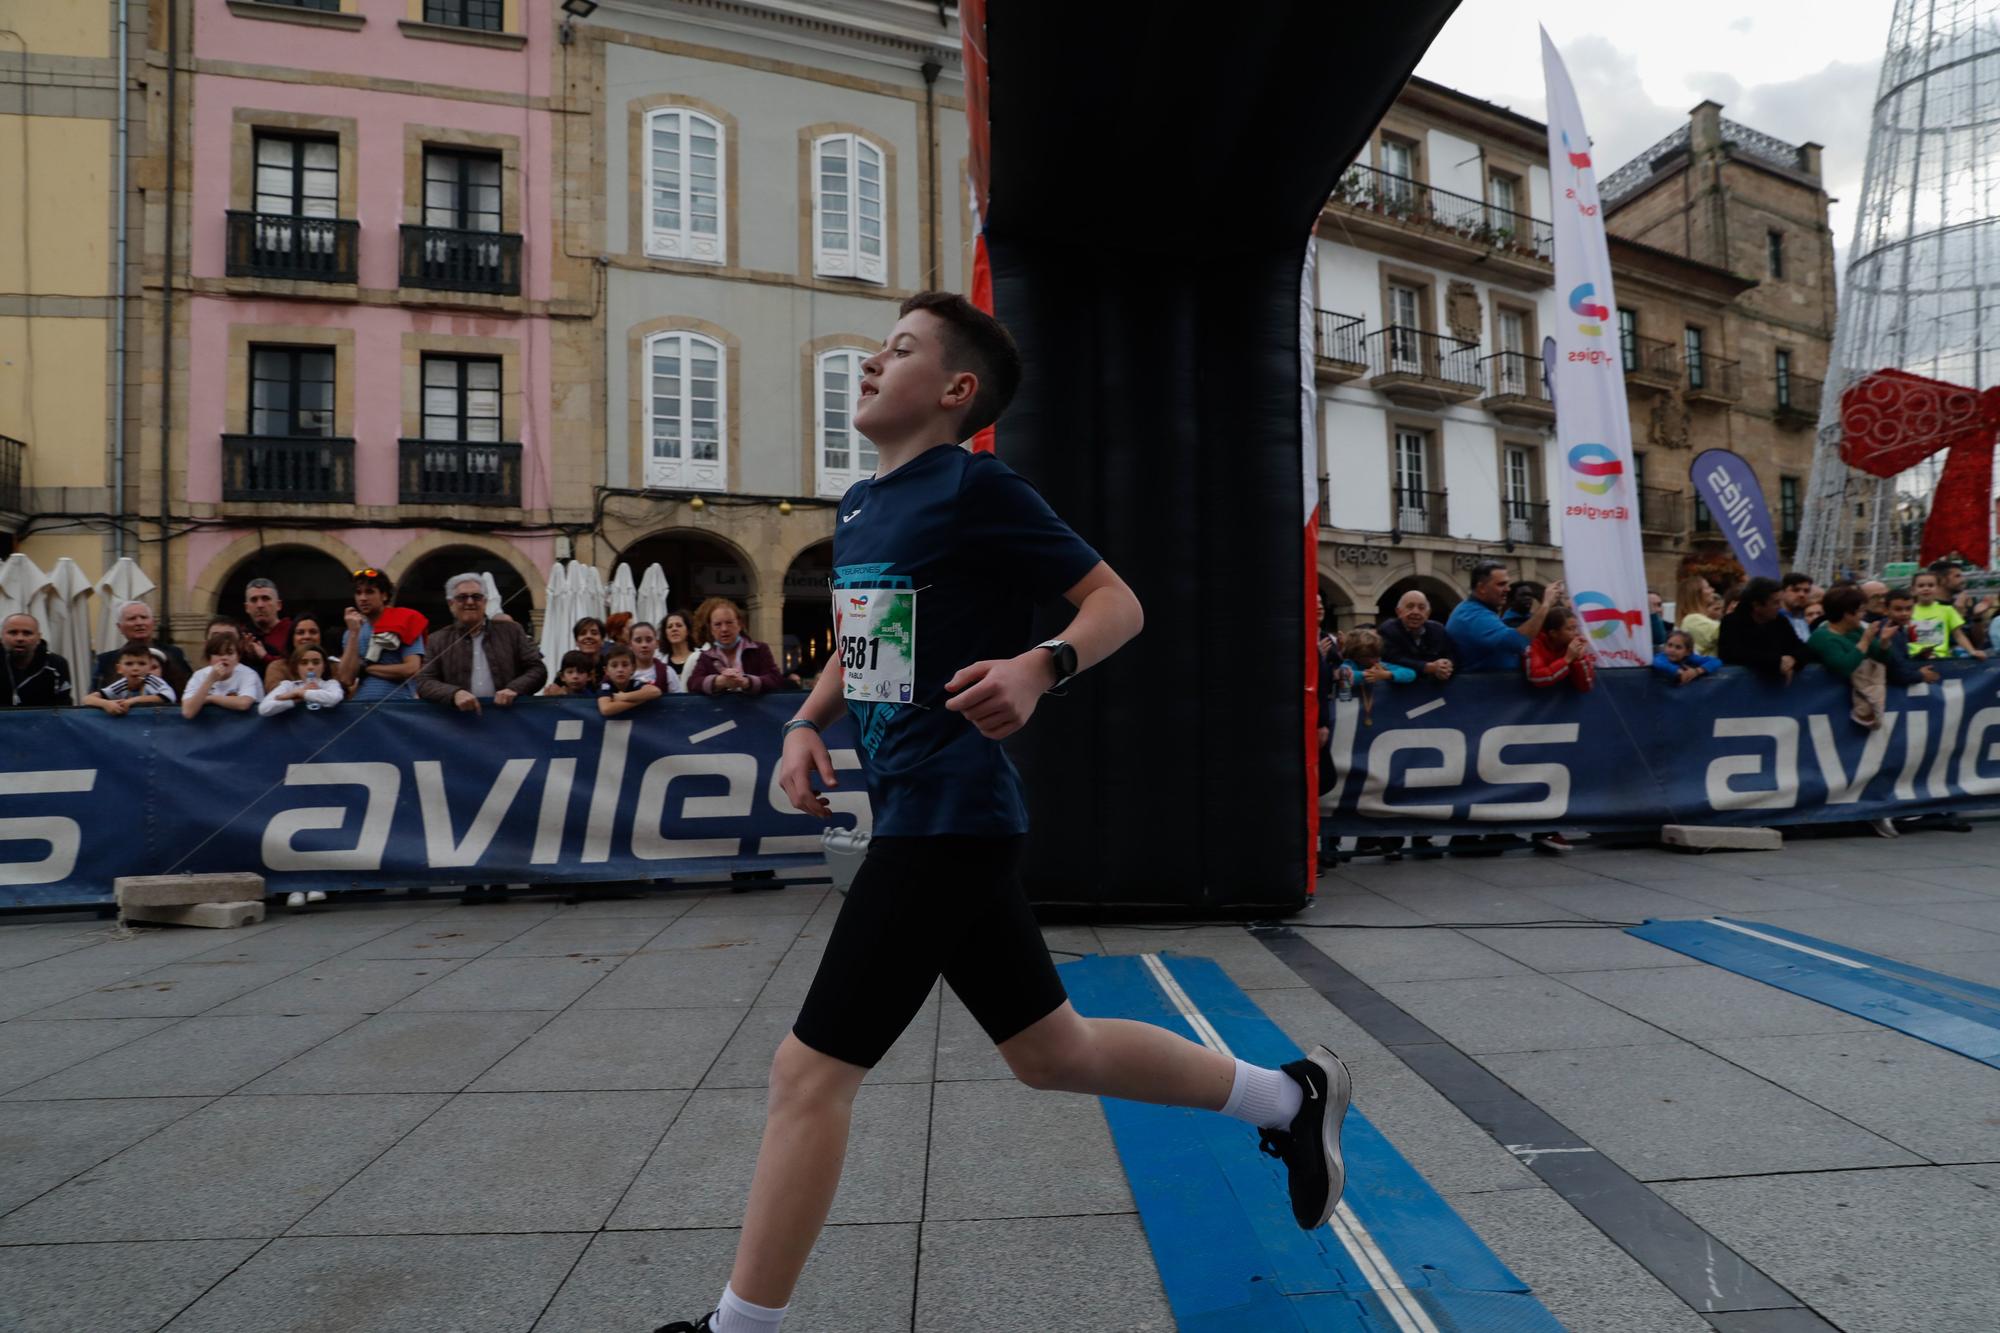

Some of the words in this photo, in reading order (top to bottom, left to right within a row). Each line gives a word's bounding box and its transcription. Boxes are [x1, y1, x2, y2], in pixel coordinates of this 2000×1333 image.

[716, 571, 736, 584] La
[840, 635, 881, 670] 2581
[848, 672, 864, 680] PABLO
[261, 720, 874, 872] avilés
